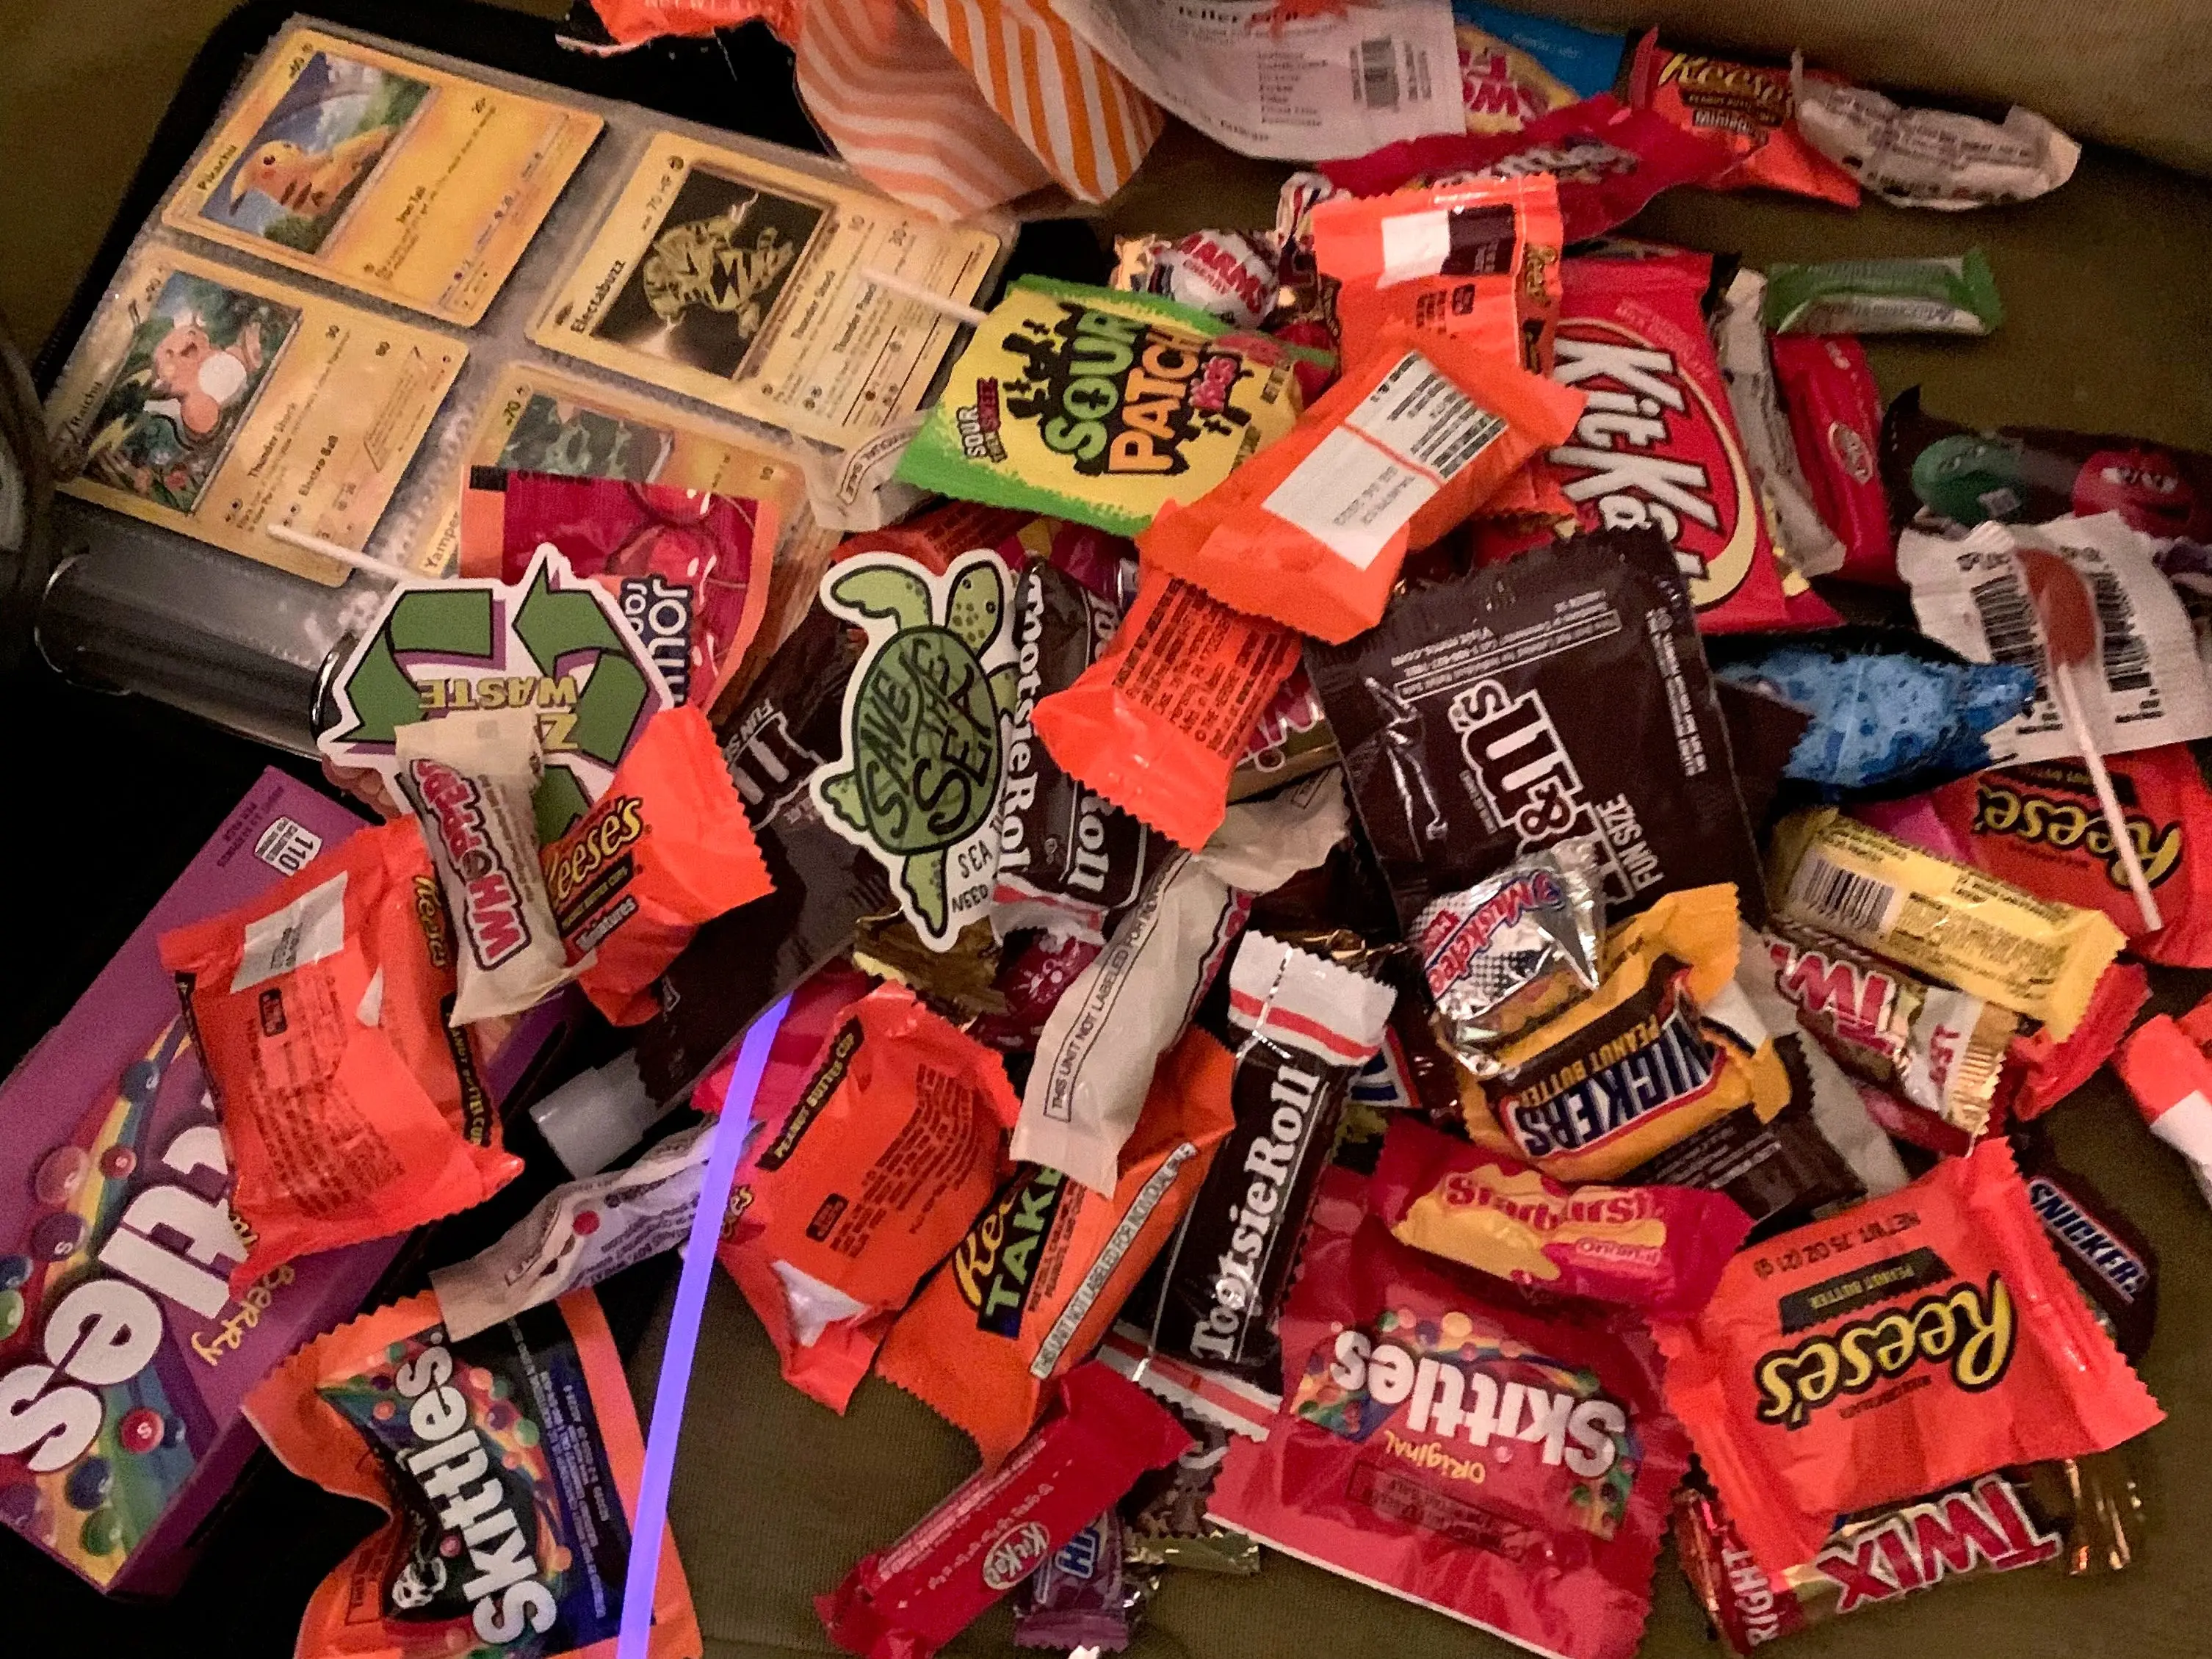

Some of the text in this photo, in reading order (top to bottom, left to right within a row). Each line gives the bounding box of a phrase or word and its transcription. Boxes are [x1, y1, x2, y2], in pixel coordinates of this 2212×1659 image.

[956, 405, 983, 458] SOUR
[1044, 308, 1137, 461] SOUR
[417, 676, 579, 710] WASTE
[861, 673, 911, 838] SAVE
[912, 661, 994, 836] SEA
[275, 830, 316, 875] 110
[413, 759, 526, 964] WHOPPERS
[546, 798, 644, 909] eese's
[958, 839, 994, 879] SEA
[1596, 793, 1664, 886] FUN SIZE
[1980, 786, 2183, 886] Reese'
[1087, 944, 1132, 1013] LABELED
[1428, 878, 1536, 994] Musketee
[1055, 1039, 1083, 1077] UNIT
[1074, 1011, 1099, 1044] NOT
[1589, 1015, 1658, 1070] PEANUT
[1044, 1075, 1074, 1111] THIS
[1760, 1273, 2012, 1424] Reese's
[1329, 1329, 1626, 1479] Skittles
[395, 1344, 557, 1645] Skittles
[1817, 1473, 2061, 1613] TWIX
[1723, 1548, 1778, 1647] RIGHT
